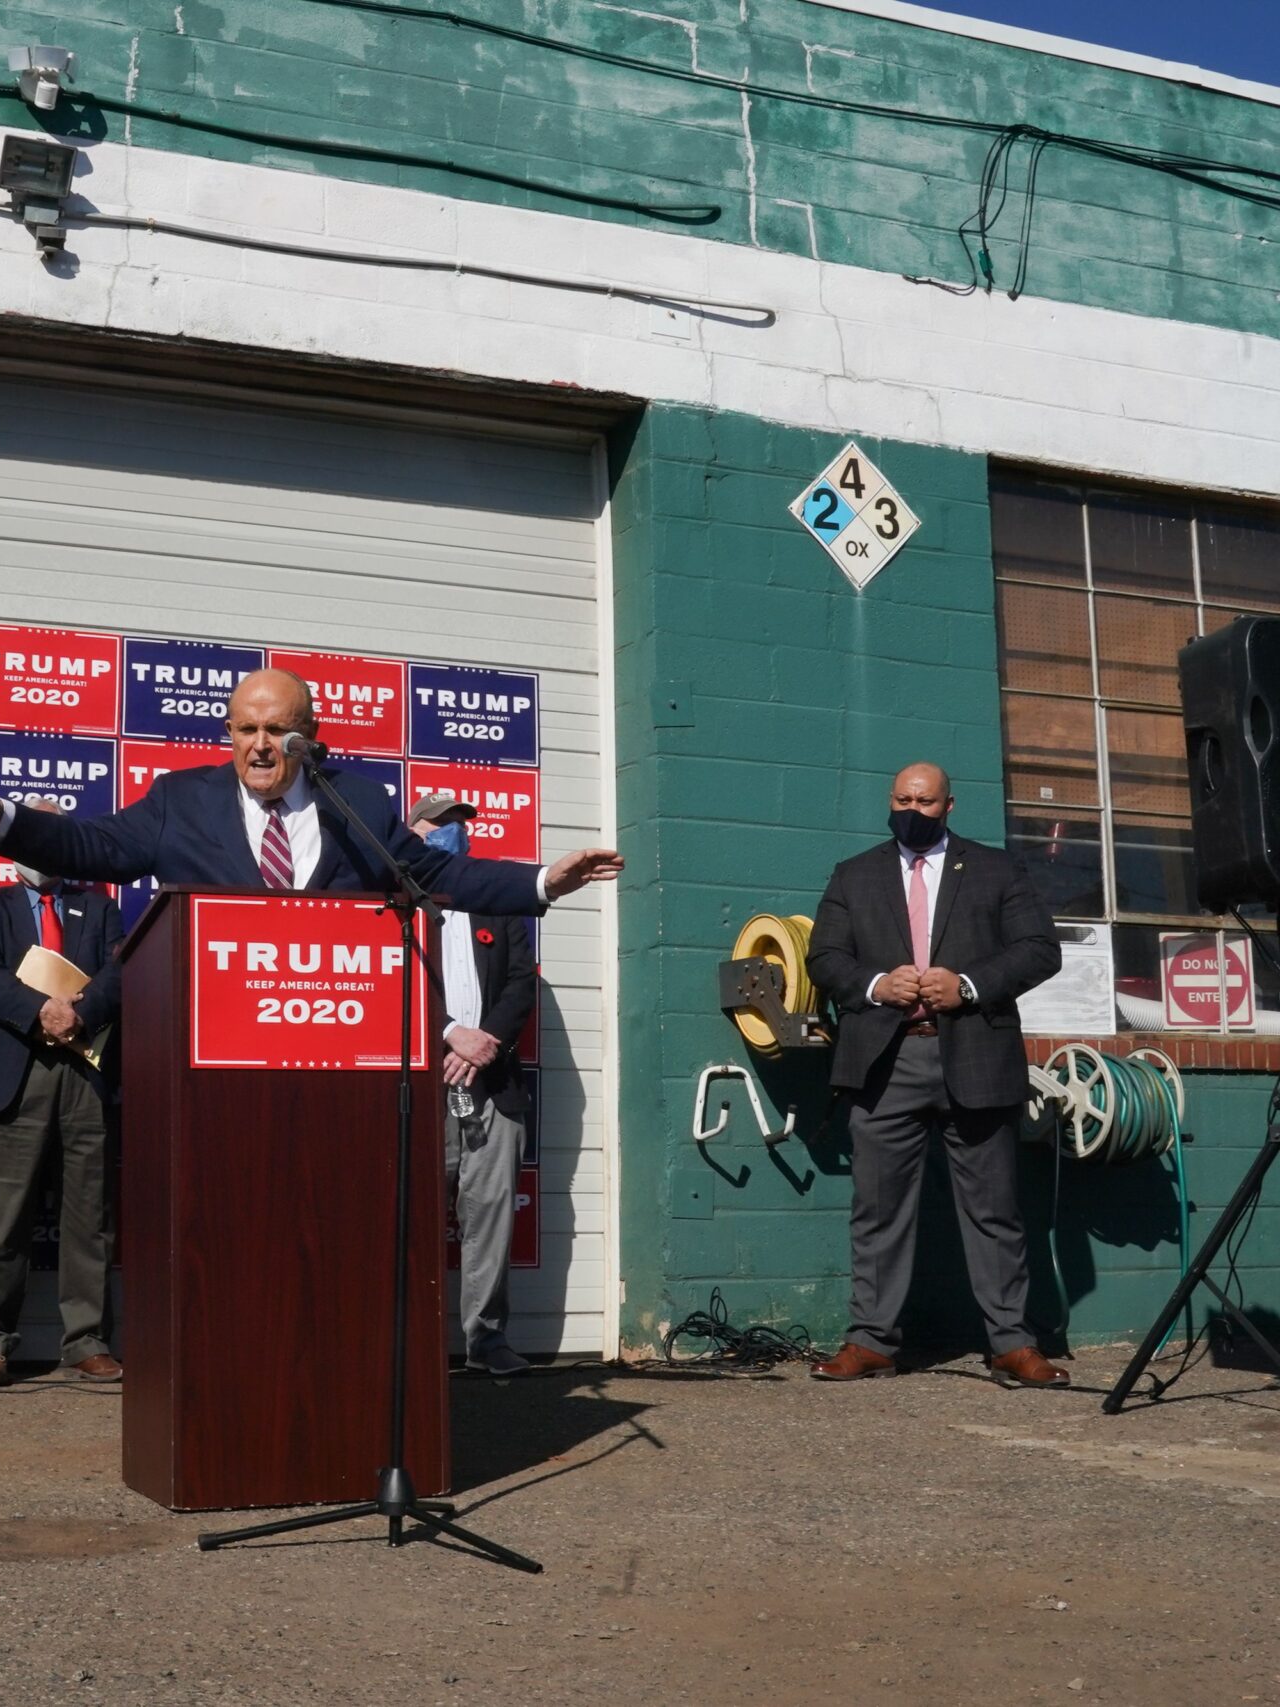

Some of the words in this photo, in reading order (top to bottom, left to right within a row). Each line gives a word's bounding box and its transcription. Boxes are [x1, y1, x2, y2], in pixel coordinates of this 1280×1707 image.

[840, 458, 865, 499] 4
[812, 488, 840, 530] 2
[874, 497, 900, 540] 3
[846, 540, 869, 558] OX
[10, 686, 80, 706] 2020
[176, 688, 207, 696] AMERICA
[305, 681, 394, 704] RUMP
[416, 688, 531, 713] TRUMP
[161, 698, 228, 718] 2020
[312, 702, 384, 718] ENCE
[444, 722, 504, 740] 2020
[22, 781, 56, 789] AMERICA
[465, 822, 504, 838] 20
[208, 941, 404, 974] TRUMP
[1182, 960, 1200, 970] DO
[246, 980, 275, 989] KEEP
[279, 981, 330, 990] AMERICA
[334, 982, 375, 992] GREAT!
[1188, 992, 1228, 1003] ENTE
[257, 998, 364, 1025] 2020
